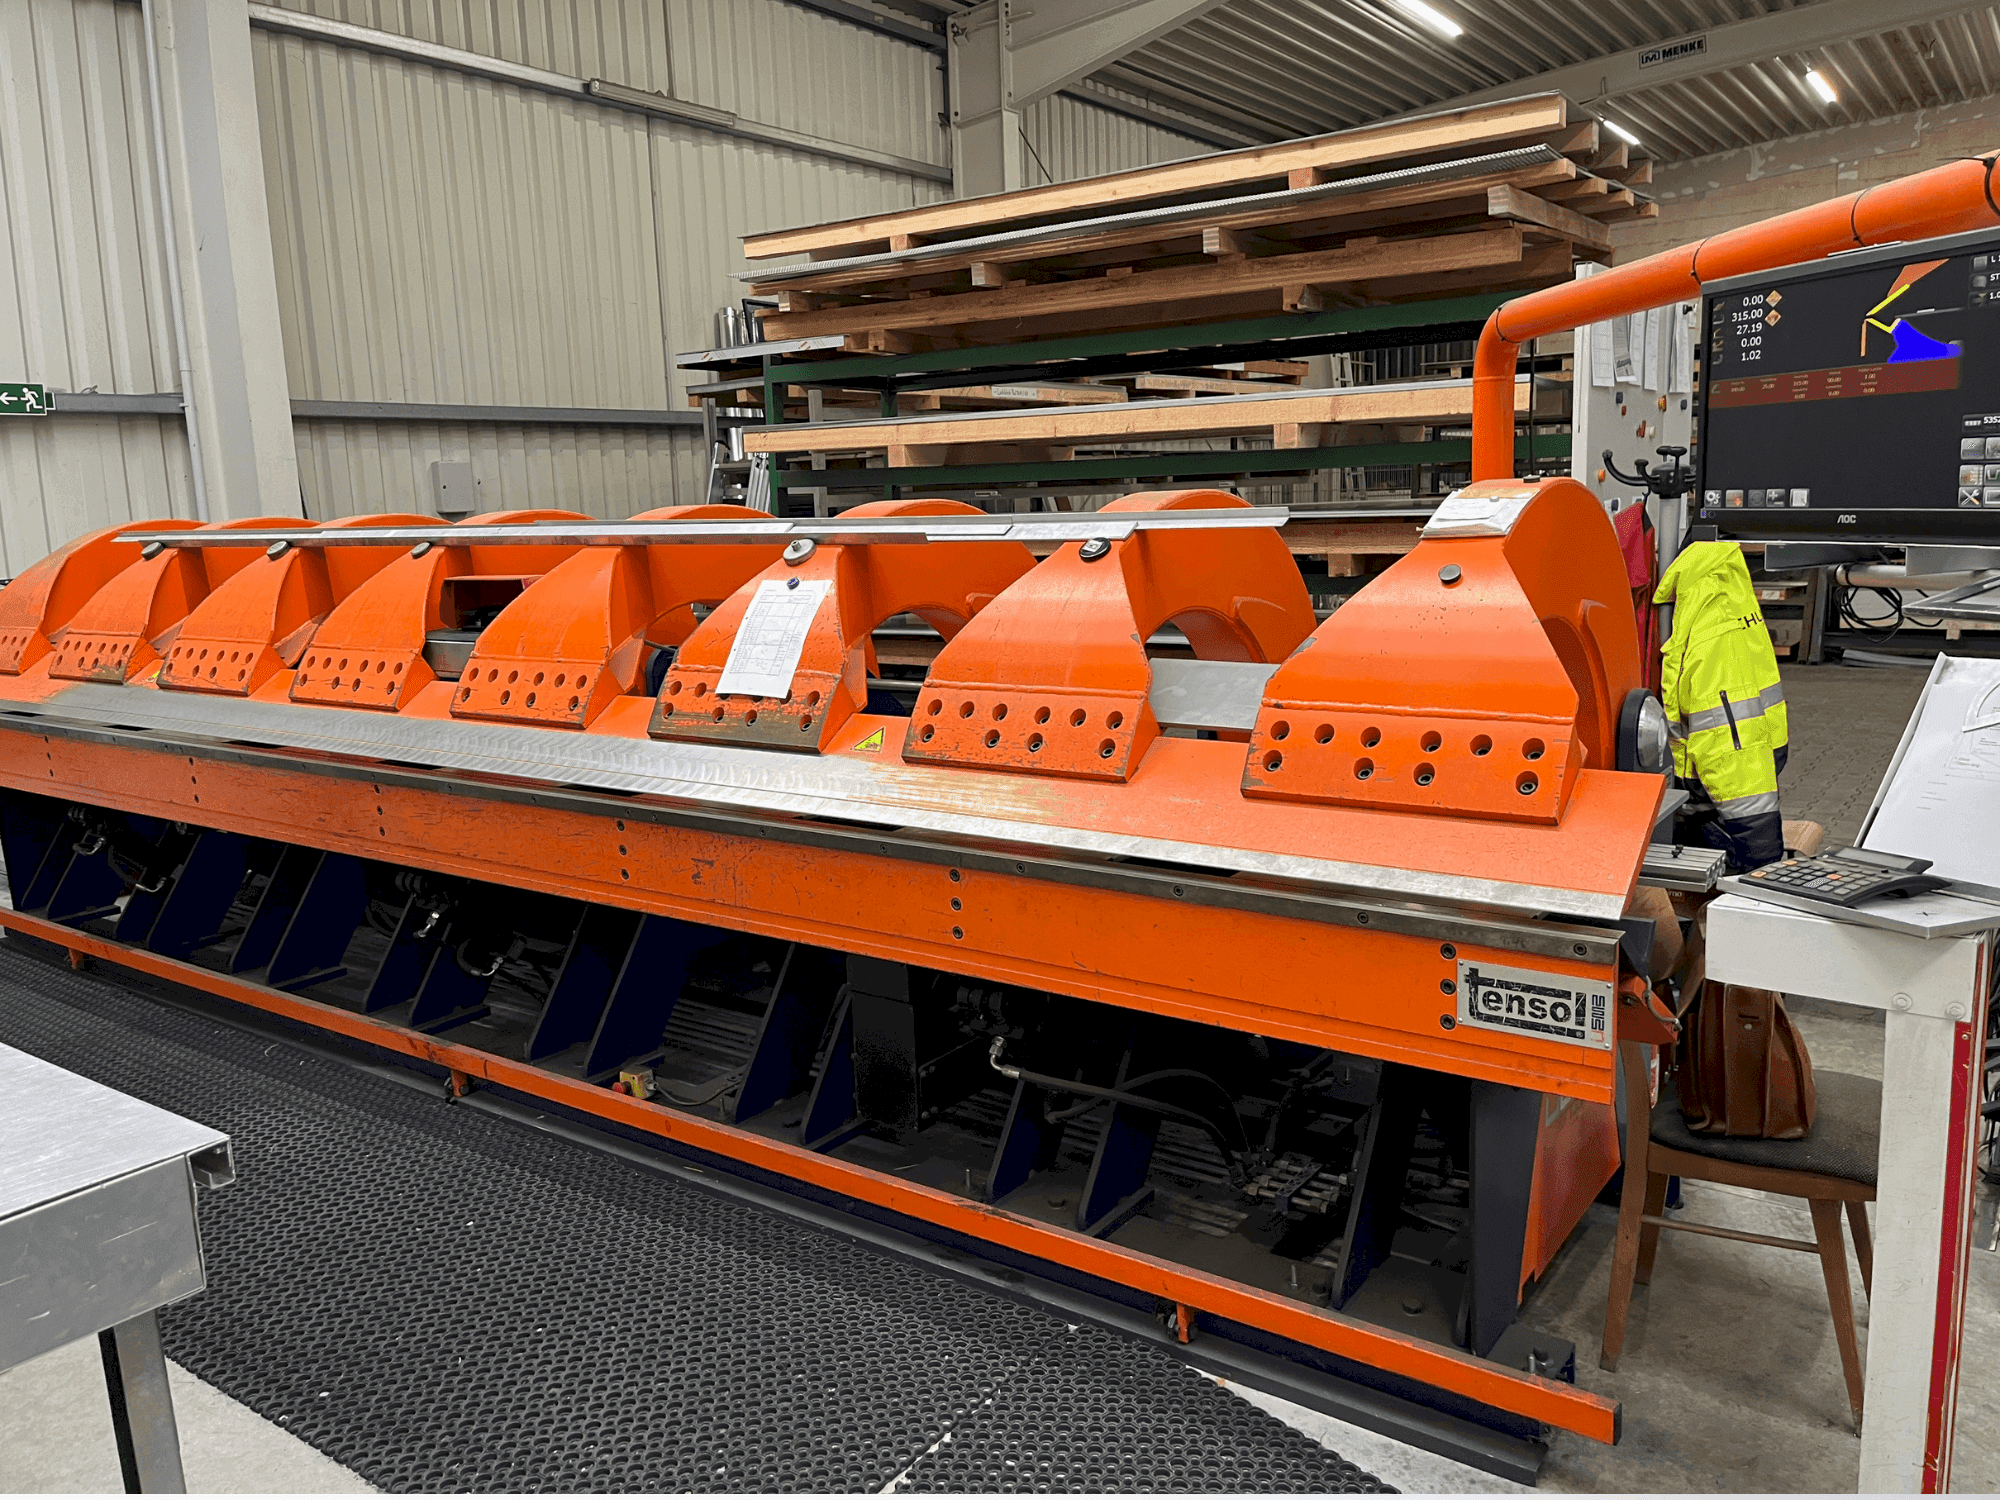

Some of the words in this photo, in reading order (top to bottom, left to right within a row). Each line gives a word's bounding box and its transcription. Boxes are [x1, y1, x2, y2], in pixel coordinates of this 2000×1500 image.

[1662, 39, 1704, 58] MENKE
[1742, 294, 1764, 307] 0.00
[1731, 308, 1763, 322] 315.00
[1736, 322, 1762, 335] 27.19
[1740, 336, 1762, 348] 0.00
[1741, 350, 1761, 361] 1.02
[1837, 514, 1857, 524] AOC
[1463, 967, 1587, 1039] tensol
